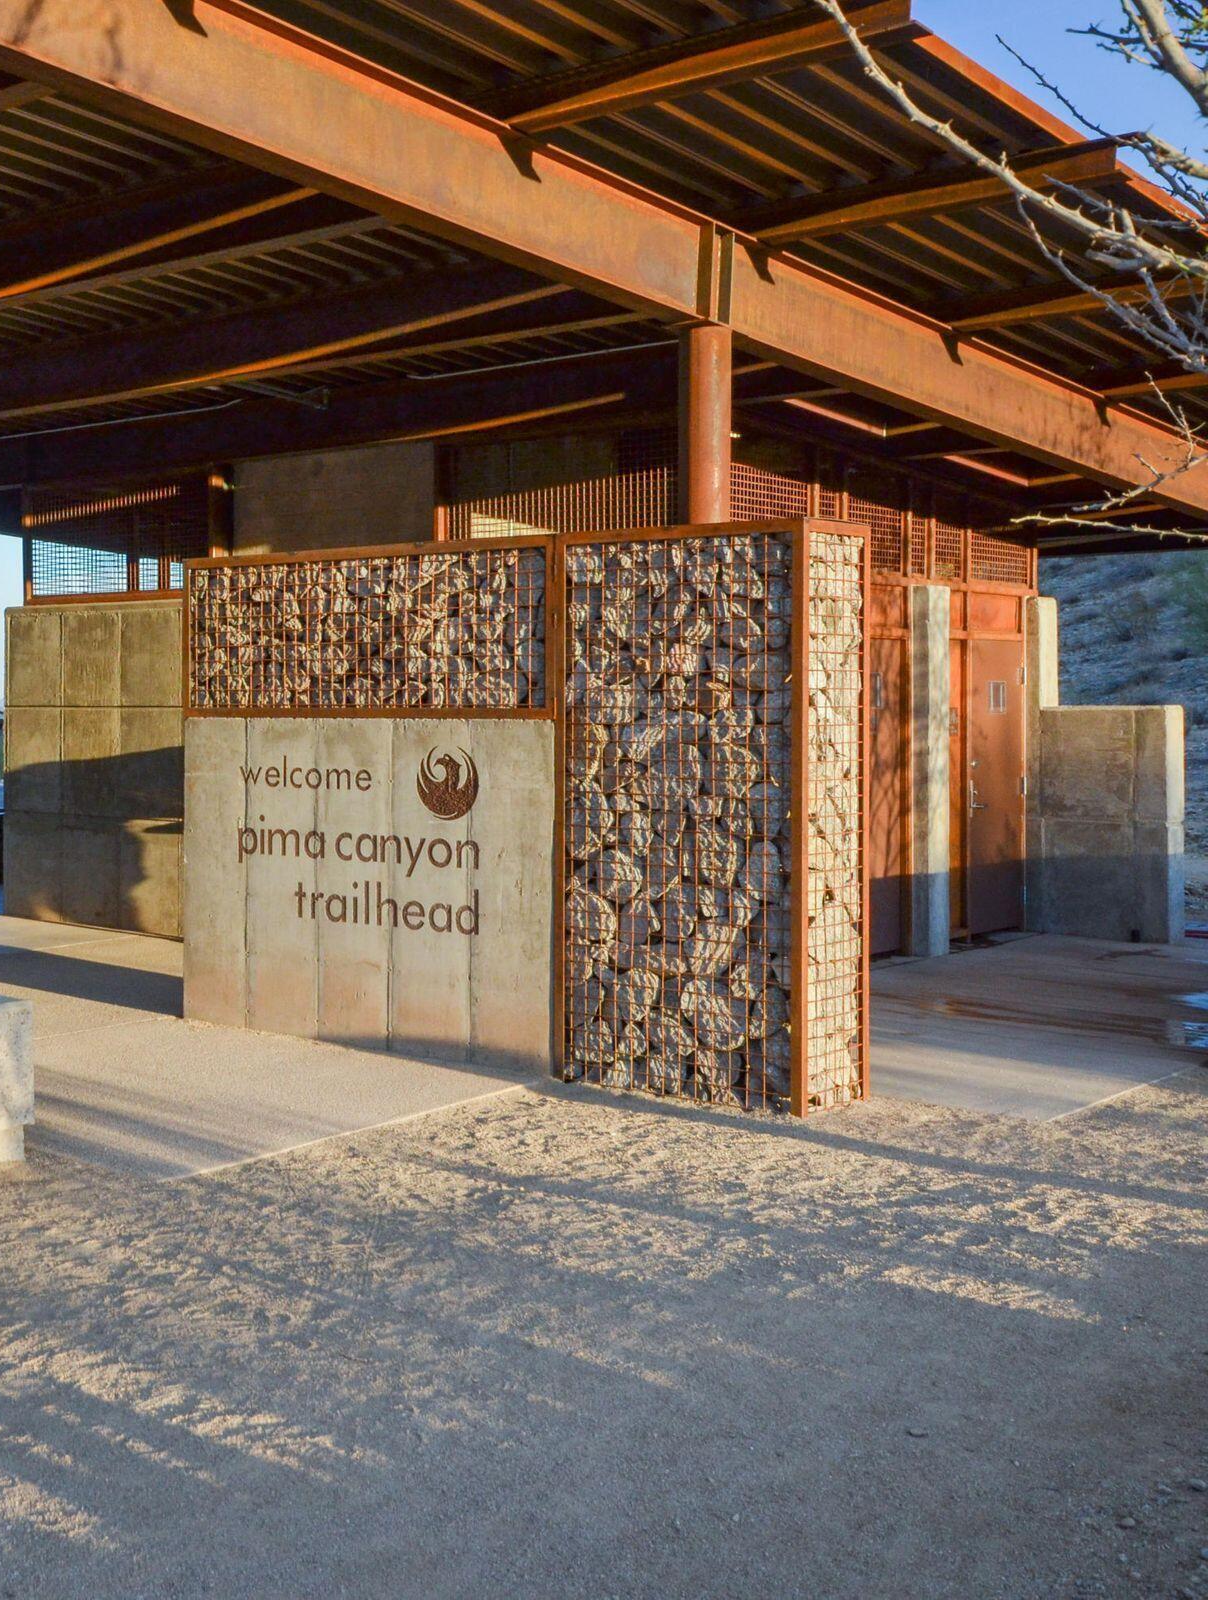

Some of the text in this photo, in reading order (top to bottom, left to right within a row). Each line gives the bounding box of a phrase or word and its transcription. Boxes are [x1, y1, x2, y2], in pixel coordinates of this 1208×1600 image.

[240, 755, 372, 792] welcome
[237, 814, 480, 877] pima canyon
[295, 880, 480, 935] trailhead
